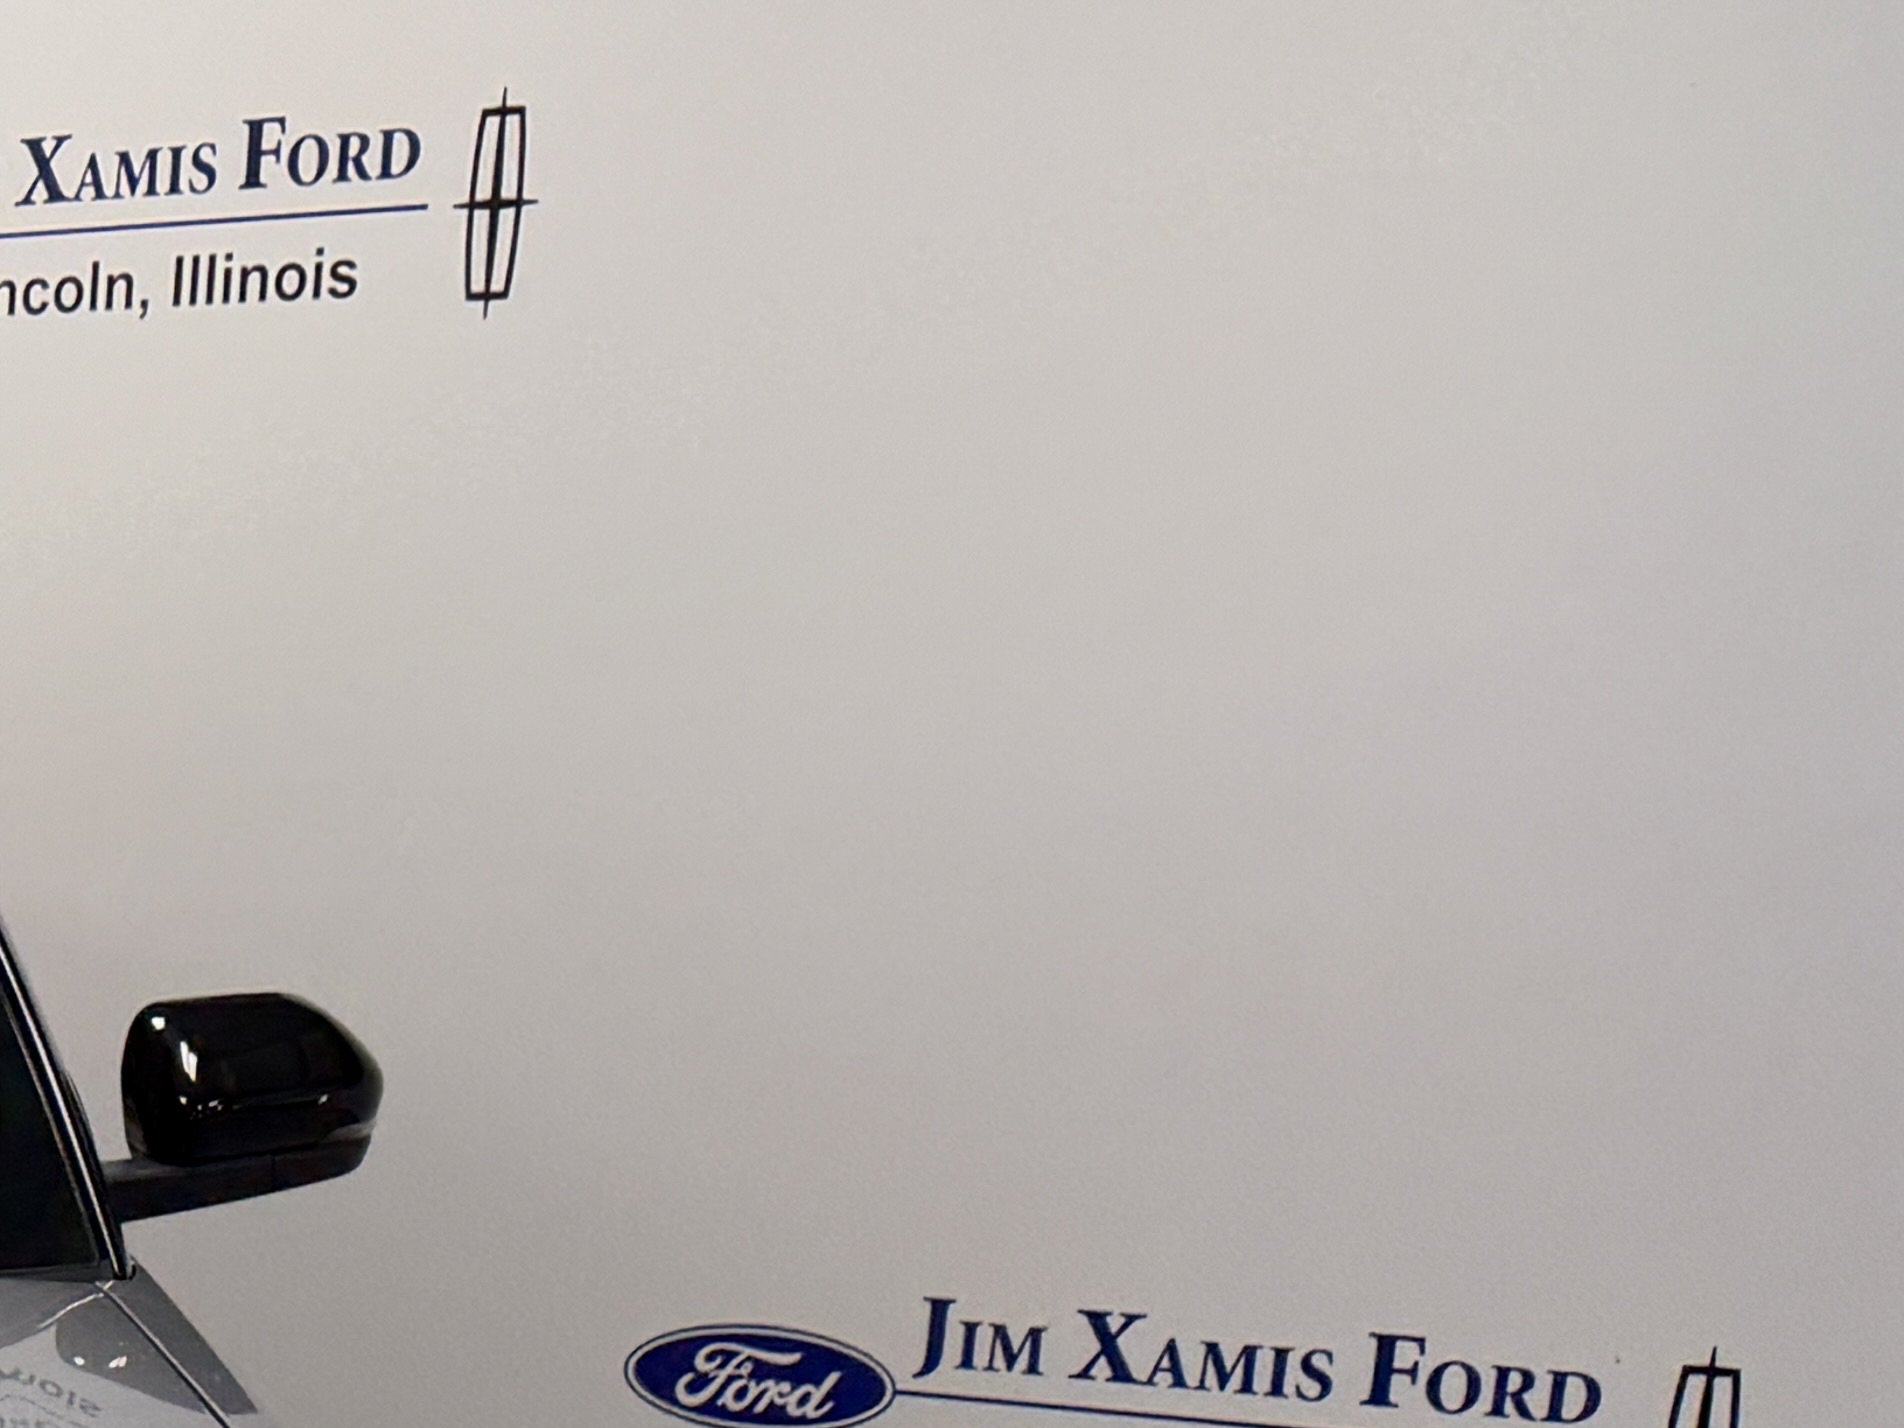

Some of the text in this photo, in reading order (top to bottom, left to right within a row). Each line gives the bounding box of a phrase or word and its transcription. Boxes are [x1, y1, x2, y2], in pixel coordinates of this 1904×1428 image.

[15, 135, 216, 206] XAMIS
[239, 117, 420, 189] FORD
[172, 248, 357, 306] Illinois
[673, 1345, 838, 1421] Ford
[912, 1297, 1601, 1424] JIM XAMIS FORD
